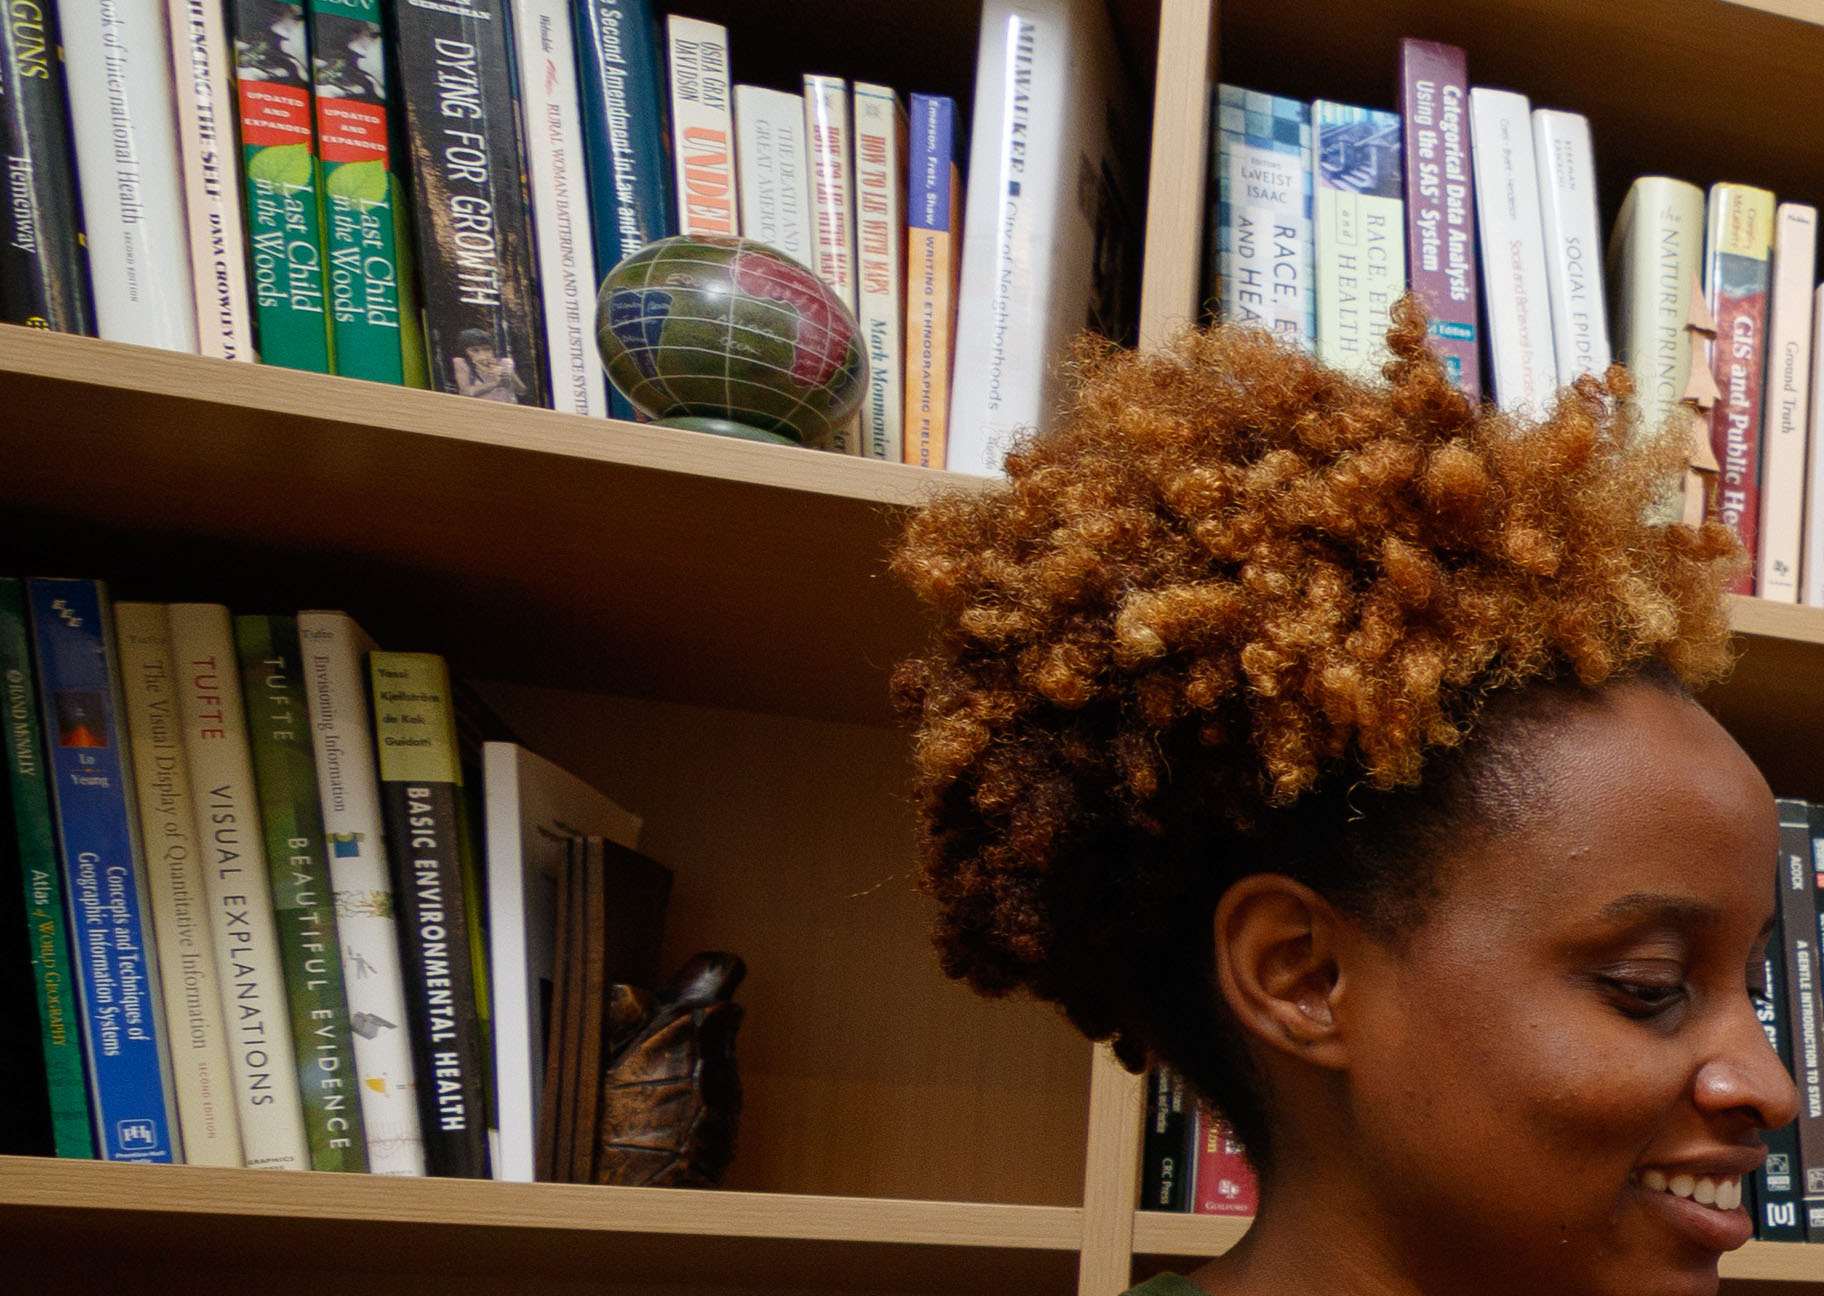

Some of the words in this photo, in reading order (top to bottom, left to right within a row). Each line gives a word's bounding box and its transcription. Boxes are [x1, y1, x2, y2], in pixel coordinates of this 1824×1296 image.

[600, 8, 622, 63] Second
[700, 40, 724, 75] OSHA
[434, 37, 482, 119] DYING
[675, 38, 700, 103] DAVIDSON
[702, 75, 727, 113] GRAY
[105, 55, 138, 164] International
[246, 91, 305, 108] UPDATED
[262, 106, 291, 118] AND
[323, 107, 381, 125] UPDATED
[605, 66, 632, 154] Amendment
[1010, 22, 1036, 174] MILWAUKEE
[1414, 79, 1435, 128] Using
[197, 103, 216, 146] THE
[244, 118, 311, 135] EXPANDED
[321, 135, 388, 153] EXPANDED
[339, 124, 368, 135] AND
[546, 103, 562, 147] RURAL
[753, 119, 769, 168] GREAT
[777, 126, 793, 156] THE
[926, 99, 941, 161] Emerson,
[1418, 129, 1438, 159] the
[1438, 83, 1466, 181] Categorical
[201, 150, 221, 197] SELF
[443, 128, 489, 184] FOR
[552, 148, 569, 199] WOMAN
[614, 156, 636, 173] in
[860, 133, 888, 167] HOW
[117, 170, 144, 224] Health
[616, 174, 637, 203] Law
[779, 160, 798, 208] DEATH
[861, 169, 888, 190] TO
[861, 190, 889, 217] LIE
[1246, 184, 1288, 204] ISAAC
[9, 156, 36, 254] Hemenway
[257, 199, 282, 228] the
[281, 182, 314, 235] Last
[358, 197, 390, 250] Last
[618, 204, 641, 236] and
[924, 190, 937, 227] Shaw
[1446, 183, 1466, 226] Data
[206, 213, 225, 258] DANA
[333, 216, 361, 243] the
[449, 195, 501, 307] GROWTH
[556, 199, 577, 268] BATTERING
[782, 211, 800, 253] AND
[862, 219, 890, 257] WITH
[1237, 214, 1256, 260] AND
[1366, 213, 1388, 281] RACE,
[1417, 207, 1440, 273] System
[252, 231, 289, 308] Woods
[287, 240, 324, 313] Child
[331, 247, 364, 324] Woods
[563, 269, 579, 298] AND
[863, 259, 891, 298] MAPS
[924, 235, 936, 297] WRITING
[1273, 222, 1297, 305] RACE,
[1444, 227, 1469, 302] Analysis
[1565, 236, 1585, 300] SOCIAL
[1659, 228, 1681, 319] NATURE
[215, 261, 234, 338] CROWLEY
[364, 255, 400, 328] Child
[565, 298, 580, 324] THE
[1338, 253, 1359, 353] HEALTH
[568, 324, 585, 372] JUSTICE
[868, 318, 890, 364] Mark
[920, 299, 936, 414] ETHNOGRAPHIC
[1732, 315, 1755, 361] GIS
[1729, 363, 1750, 408] and
[1782, 340, 1800, 394] Ground
[870, 366, 891, 461] Monmonier
[1780, 396, 1799, 435] Truth
[1725, 412, 1750, 486] Public
[142, 660, 163, 696] The
[192, 655, 227, 740] TUFTE
[147, 700, 170, 749] Visual
[314, 655, 332, 732] Envisioning
[323, 732, 347, 813] Information
[154, 752, 178, 818] Display
[164, 819, 179, 838] of
[209, 784, 240, 880] VISUAL
[406, 785, 437, 850] BASIC
[32, 869, 51, 907] Atlas
[78, 851, 101, 928] Geographic
[106, 865, 128, 926] Concepts
[167, 844, 195, 949] Quantitative
[1789, 853, 1805, 892] ACOCK
[262, 656, 297, 743] TUFTE
[287, 836, 328, 992] BEAUTIFUL
[311, 1007, 352, 1151] EVIDENCE
[115, 926, 134, 951] and
[413, 856, 457, 1044] ENVIRONMENTAL
[1796, 940, 1809, 950] A
[86, 928, 111, 1005] Information
[118, 951, 143, 1026] Techniques
[1797, 949, 1813, 989] GENTLE
[182, 951, 208, 1051] Information
[223, 894, 275, 1107] EXPLANATIONS
[94, 1004, 120, 1057] Systems
[128, 1026, 149, 1043] of
[1800, 988, 1819, 1069] INTRODUCTION
[432, 1049, 467, 1132] HEALTH
[1805, 1069, 1820, 1084] TO
[1807, 1083, 1823, 1119] STATA
[1161, 1157, 1176, 1179] CRC
[1159, 1180, 1173, 1206] Press
[1766, 1201, 1797, 1228] [U]
